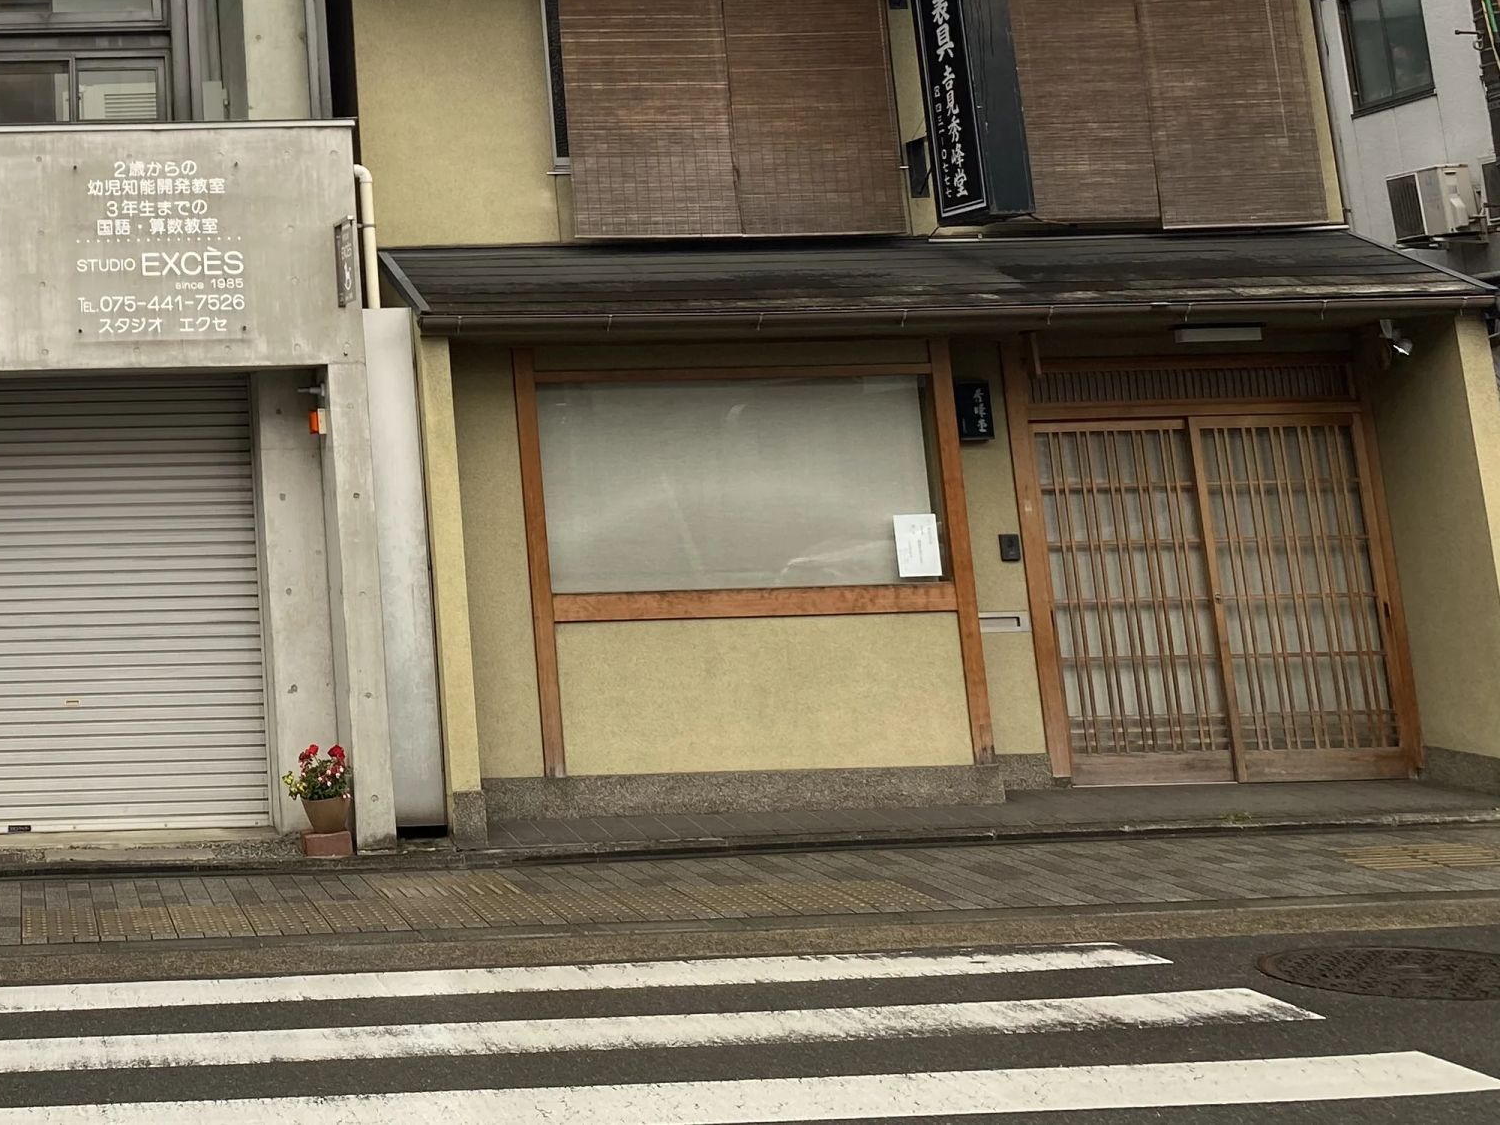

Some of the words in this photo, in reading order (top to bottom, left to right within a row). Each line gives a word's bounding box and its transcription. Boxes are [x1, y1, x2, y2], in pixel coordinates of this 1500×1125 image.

[942, 65, 969, 197] 吉見秀峰堂
[113, 160, 198, 178] 2歳からの
[87, 178, 226, 196] 幼児知能開発教室
[106, 199, 208, 218] 3年生までの
[97, 218, 219, 236] 国語・算数教室
[76, 257, 136, 273] STUDIO
[141, 246, 244, 276] EXCÈS
[175, 281, 204, 290] since
[210, 278, 244, 289] 1985
[100, 293, 245, 312] 075-441-7526
[99, 317, 163, 333] スタジオ
[179, 317, 227, 332] エクセ
